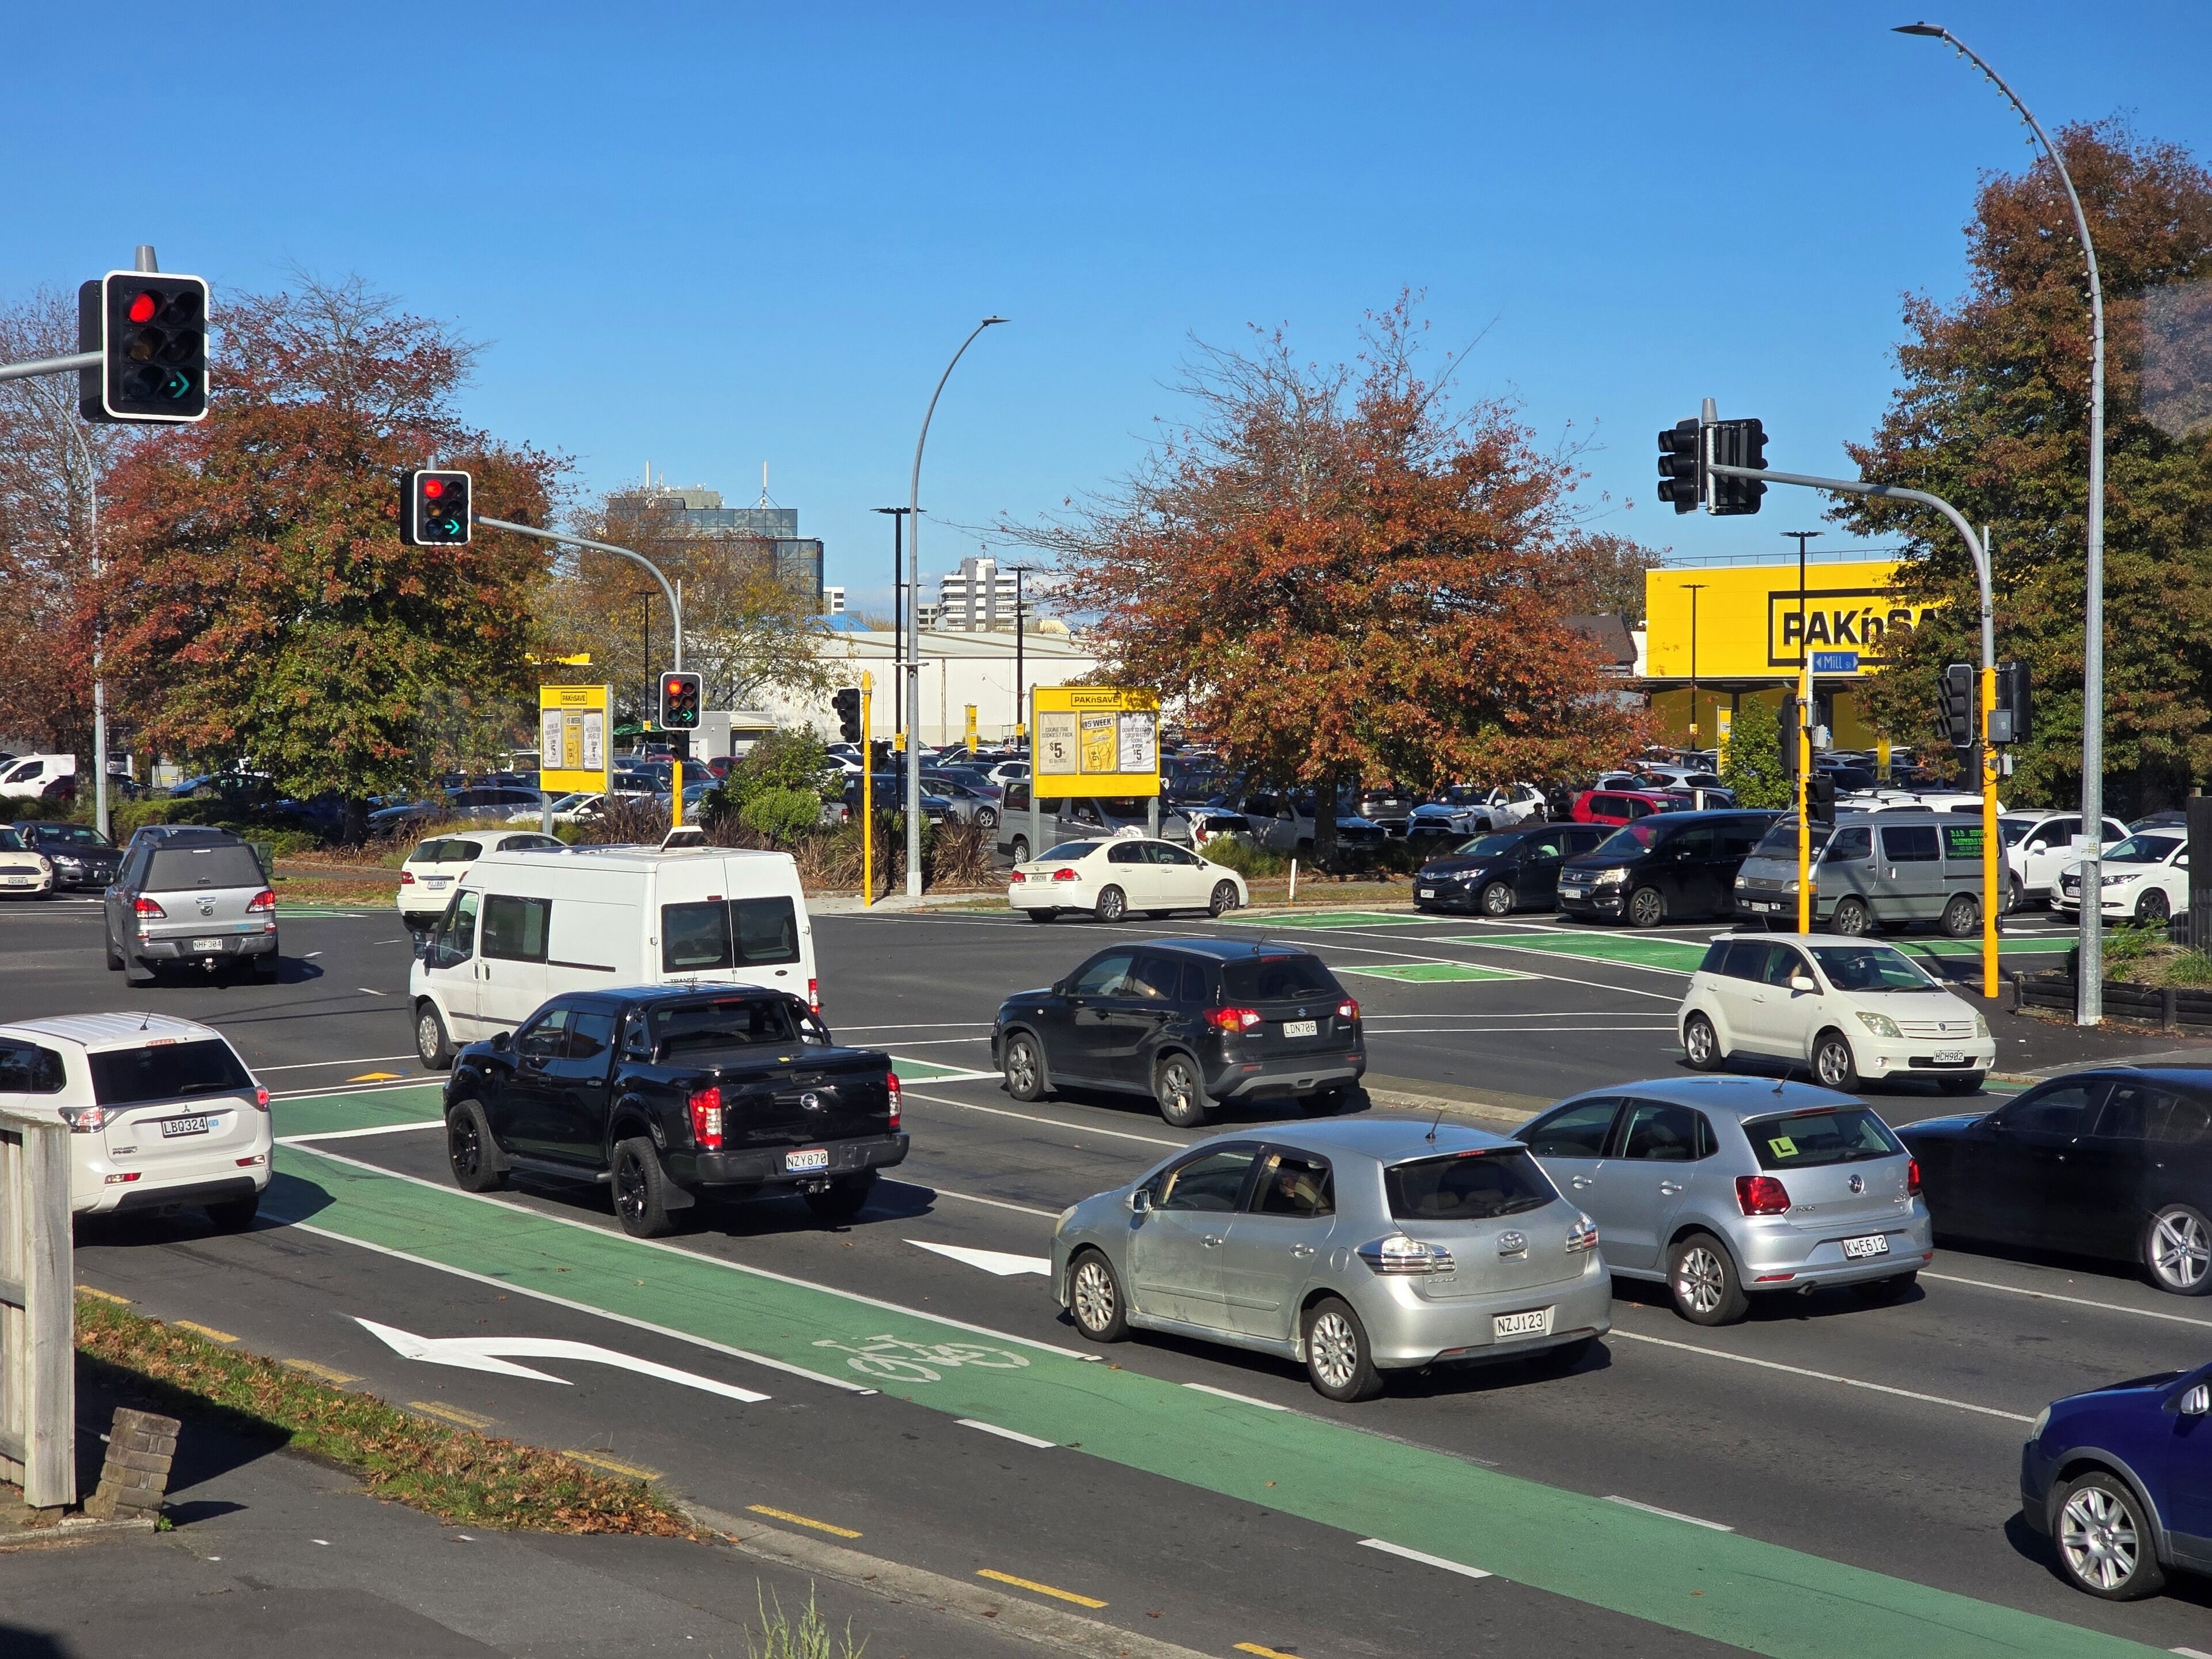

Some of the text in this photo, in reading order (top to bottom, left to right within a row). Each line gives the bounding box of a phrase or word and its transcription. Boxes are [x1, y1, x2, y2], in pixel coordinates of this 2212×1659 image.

[1824, 656, 1842, 669] Mill
[1093, 718, 1111, 727] WEEK
[1050, 741, 1062, 758] $5
[1133, 749, 1142, 760] $5
[164, 1118, 206, 1134] LBQ324
[1774, 1141, 1793, 1153] L
[787, 1153, 826, 1168] NZY870
[1846, 1237, 1887, 1256] KWE612
[1498, 1313, 1543, 1334] NZJ123
